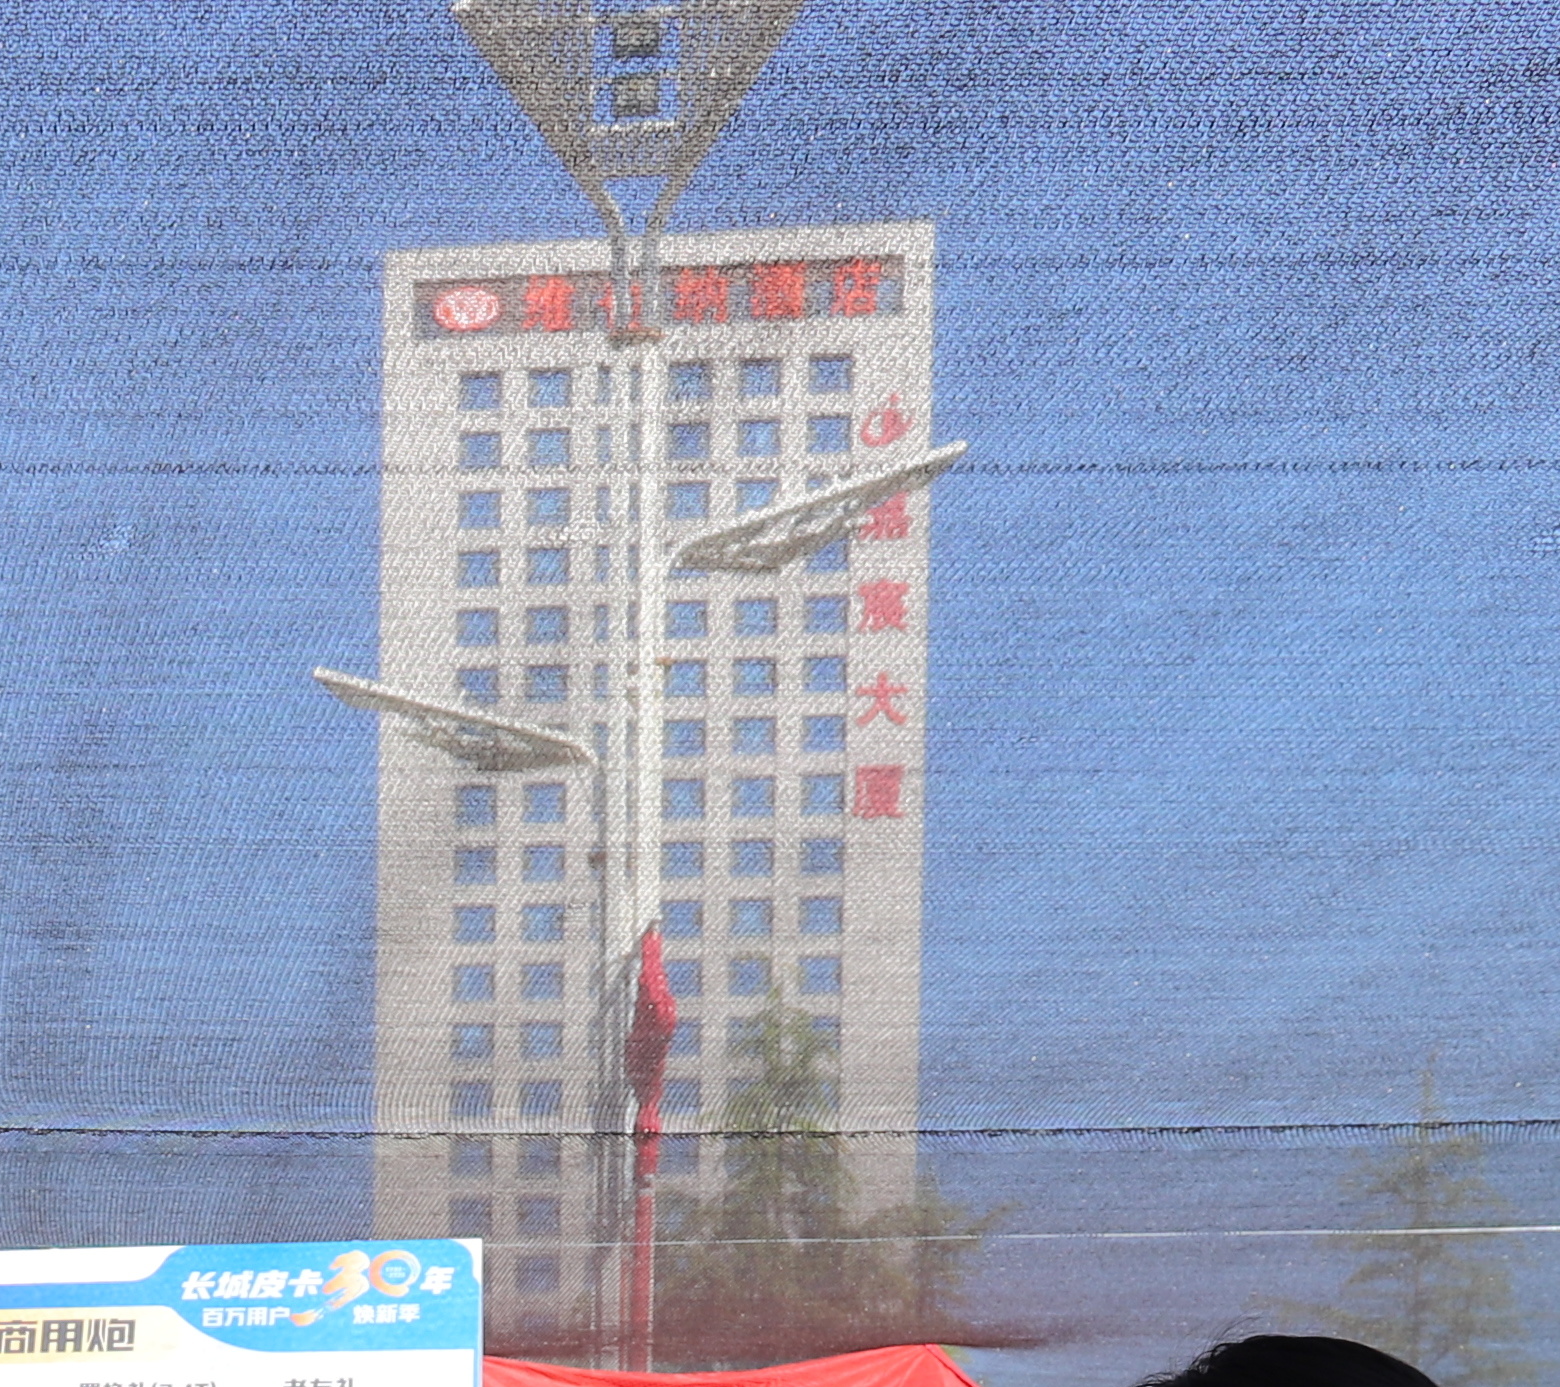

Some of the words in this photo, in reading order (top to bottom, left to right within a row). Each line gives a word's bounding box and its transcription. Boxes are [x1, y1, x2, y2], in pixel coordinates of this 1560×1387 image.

[202, 1306, 291, 1327] 百万用户
[352, 1303, 420, 1325] 焕新季
